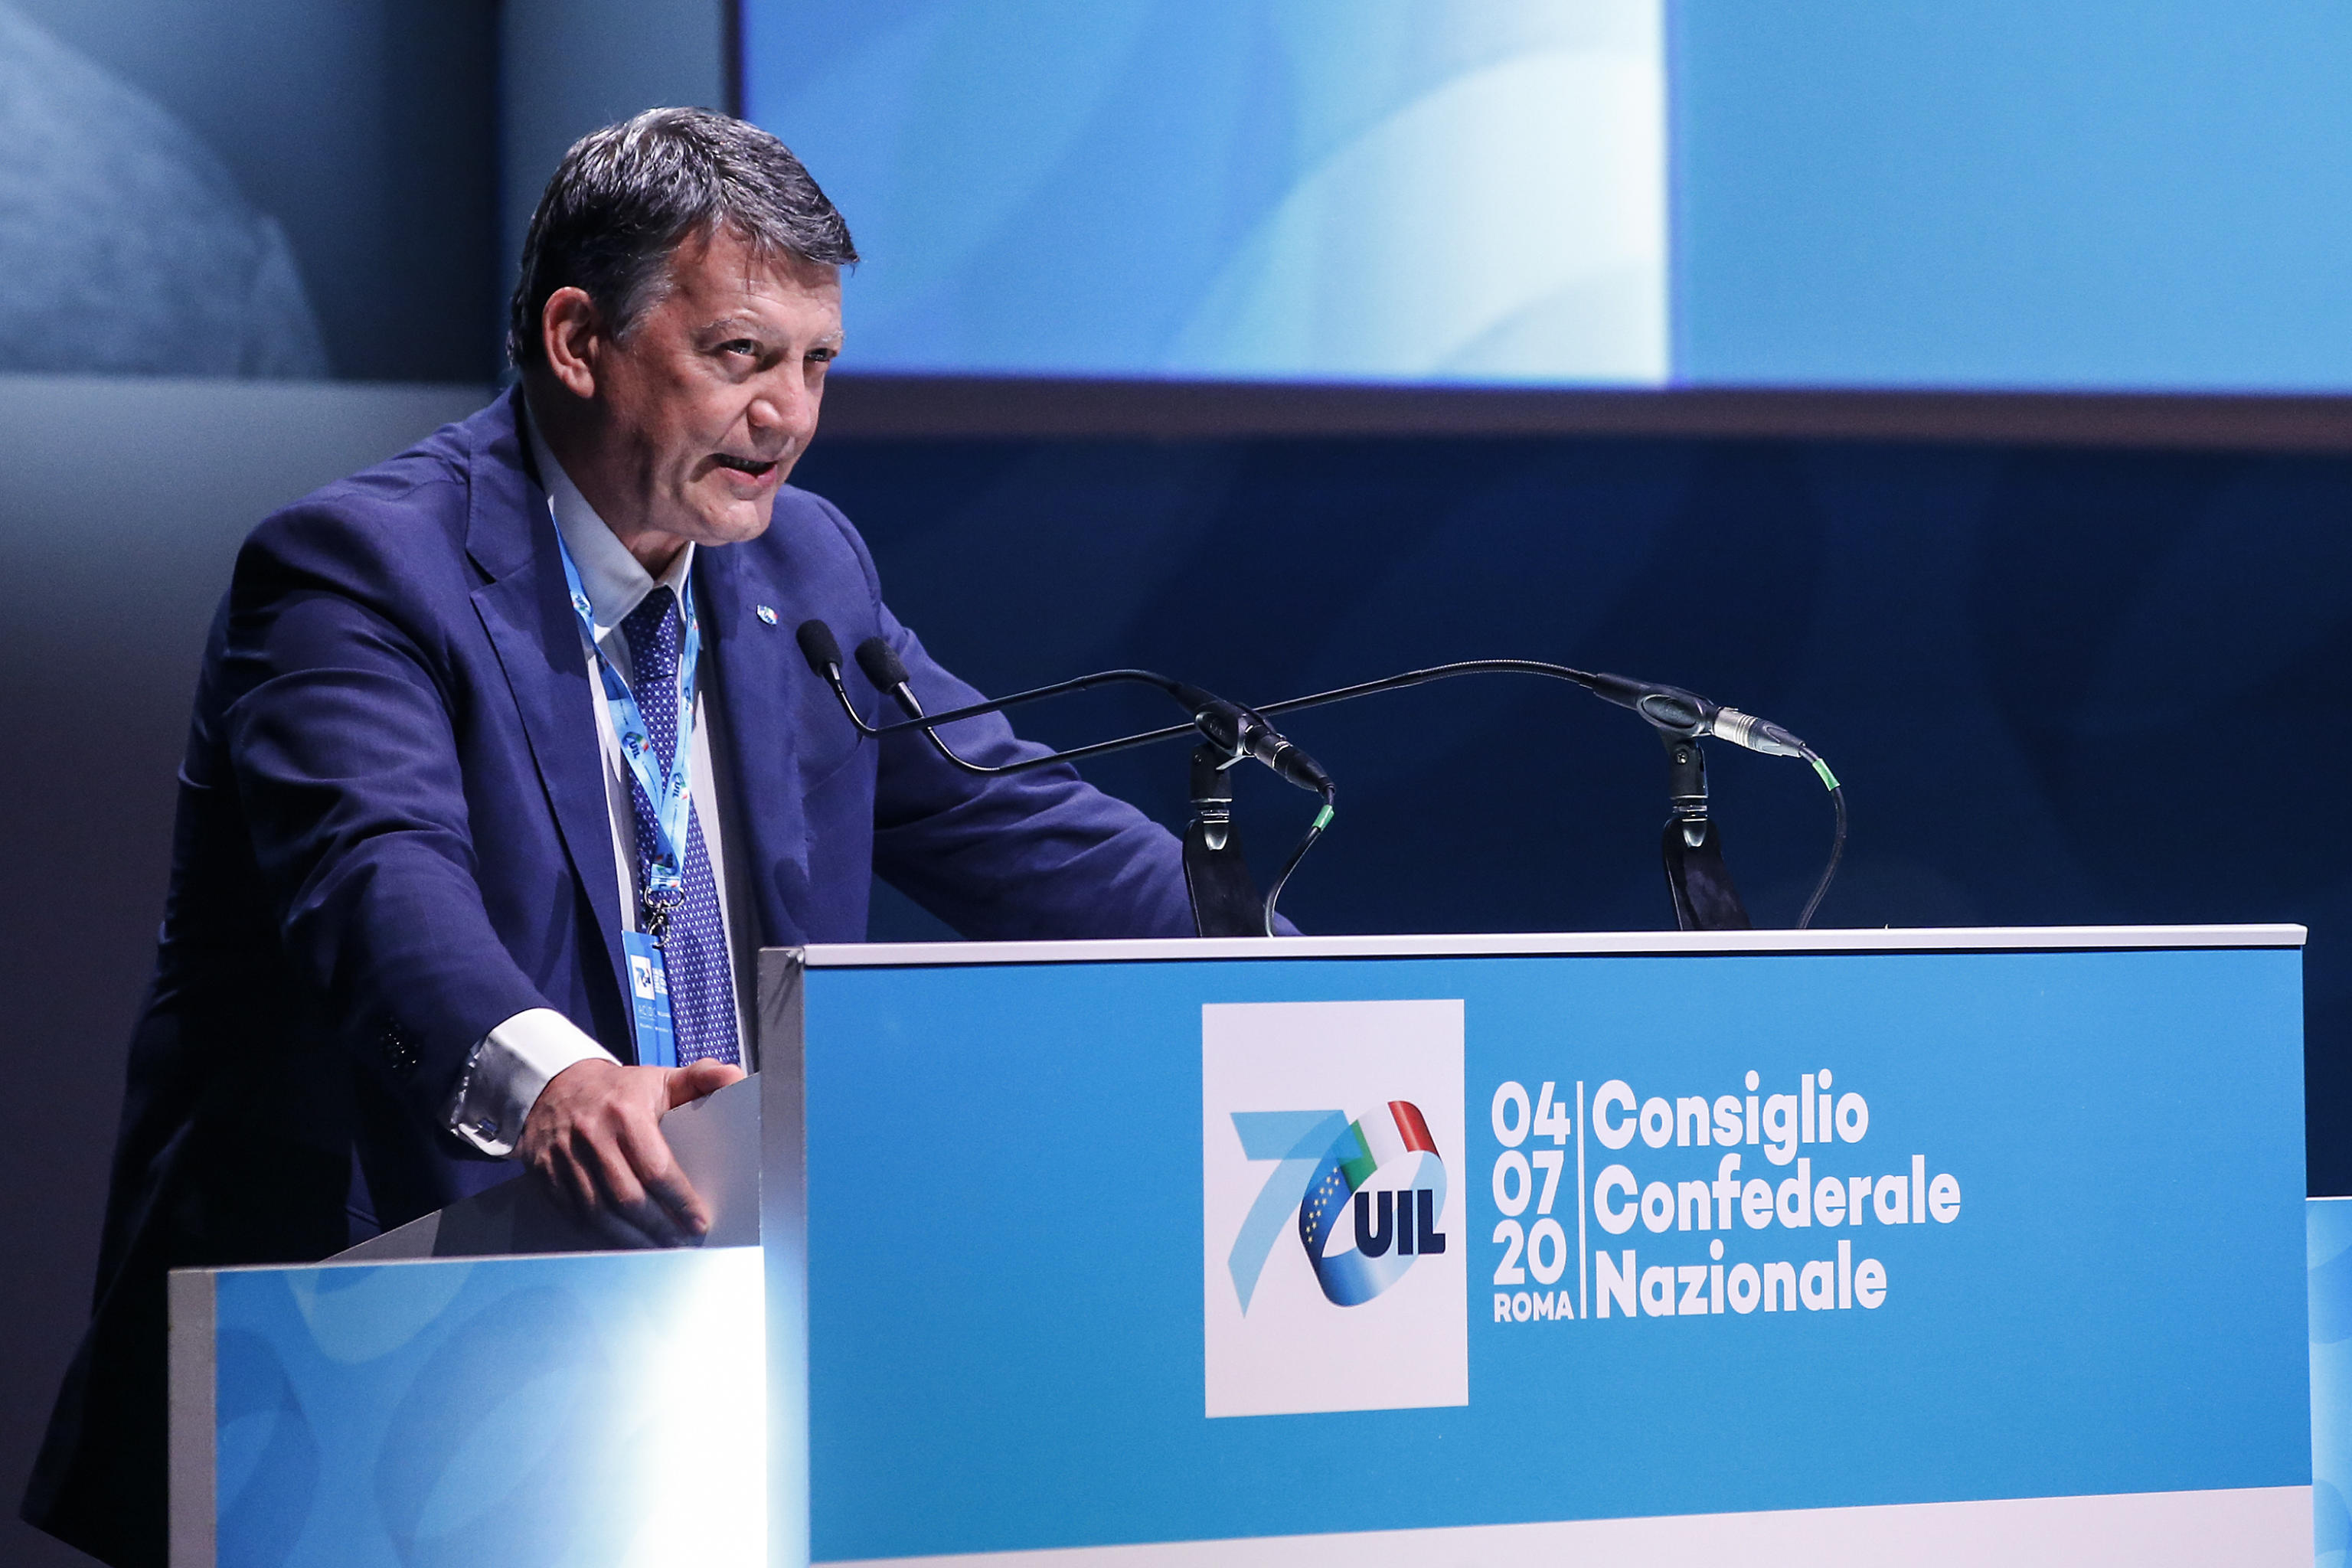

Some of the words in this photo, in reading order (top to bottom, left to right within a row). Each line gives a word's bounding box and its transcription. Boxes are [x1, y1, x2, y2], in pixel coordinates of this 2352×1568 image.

[629, 740, 640, 760] UIL
[672, 781, 681, 798] UIL
[1491, 1080, 1571, 1148] 04
[1592, 1068, 1870, 1166] Consiglio
[1491, 1149, 1565, 1217] 07
[1593, 1152, 1962, 1235] Confederale
[1353, 1188, 1446, 1258] UIL
[1492, 1217, 1567, 1285] 20
[1494, 1290, 1575, 1323] ROMA
[1595, 1238, 1887, 1319] Nazionale
